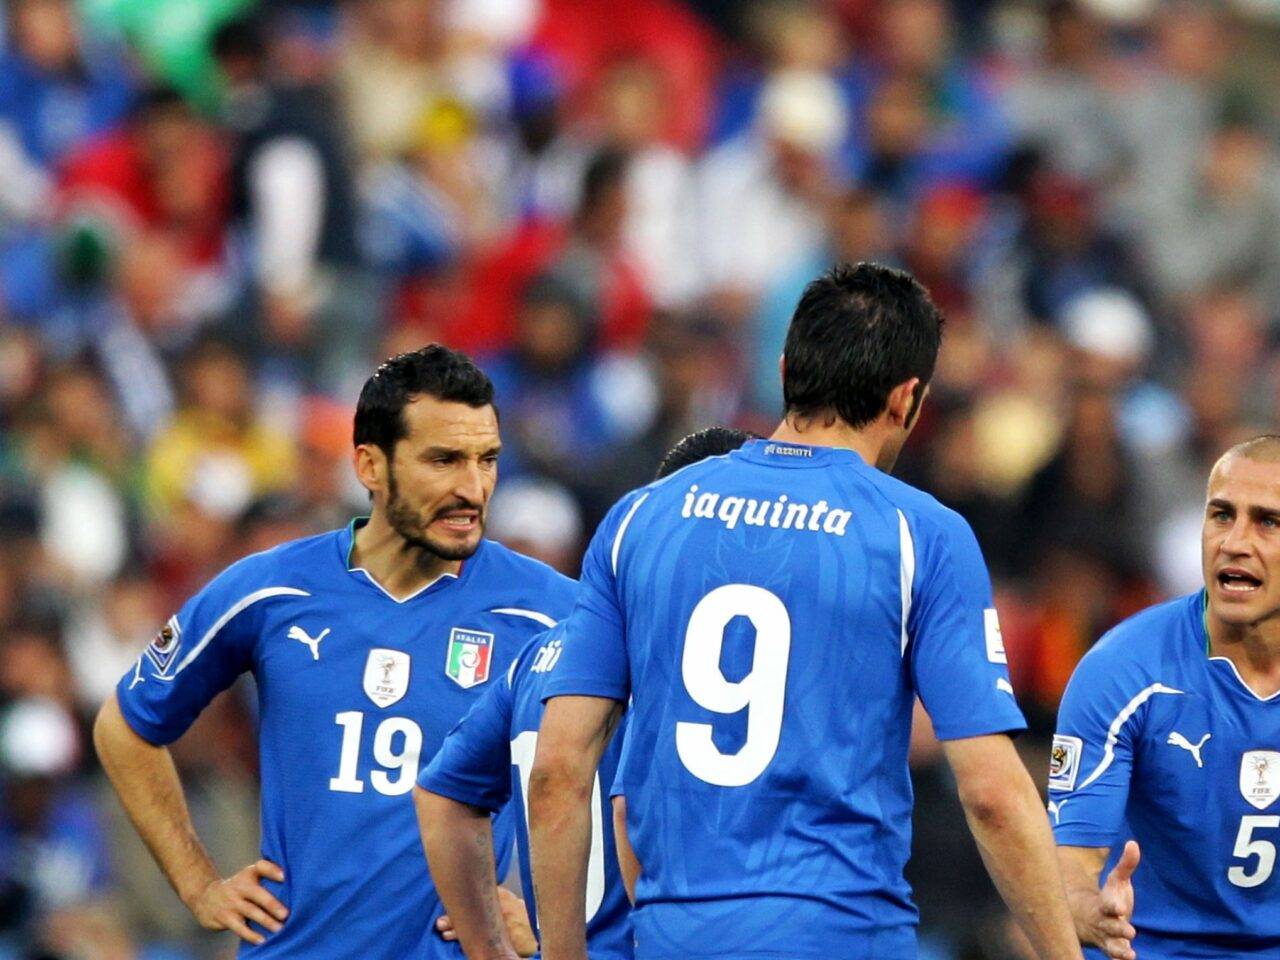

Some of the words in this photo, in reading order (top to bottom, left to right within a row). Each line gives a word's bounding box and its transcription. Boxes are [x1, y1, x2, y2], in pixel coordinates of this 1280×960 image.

[681, 484, 853, 537] iaquinta
[455, 633, 488, 645] ITALIA
[675, 583, 792, 788] 9
[329, 710, 423, 796] 19
